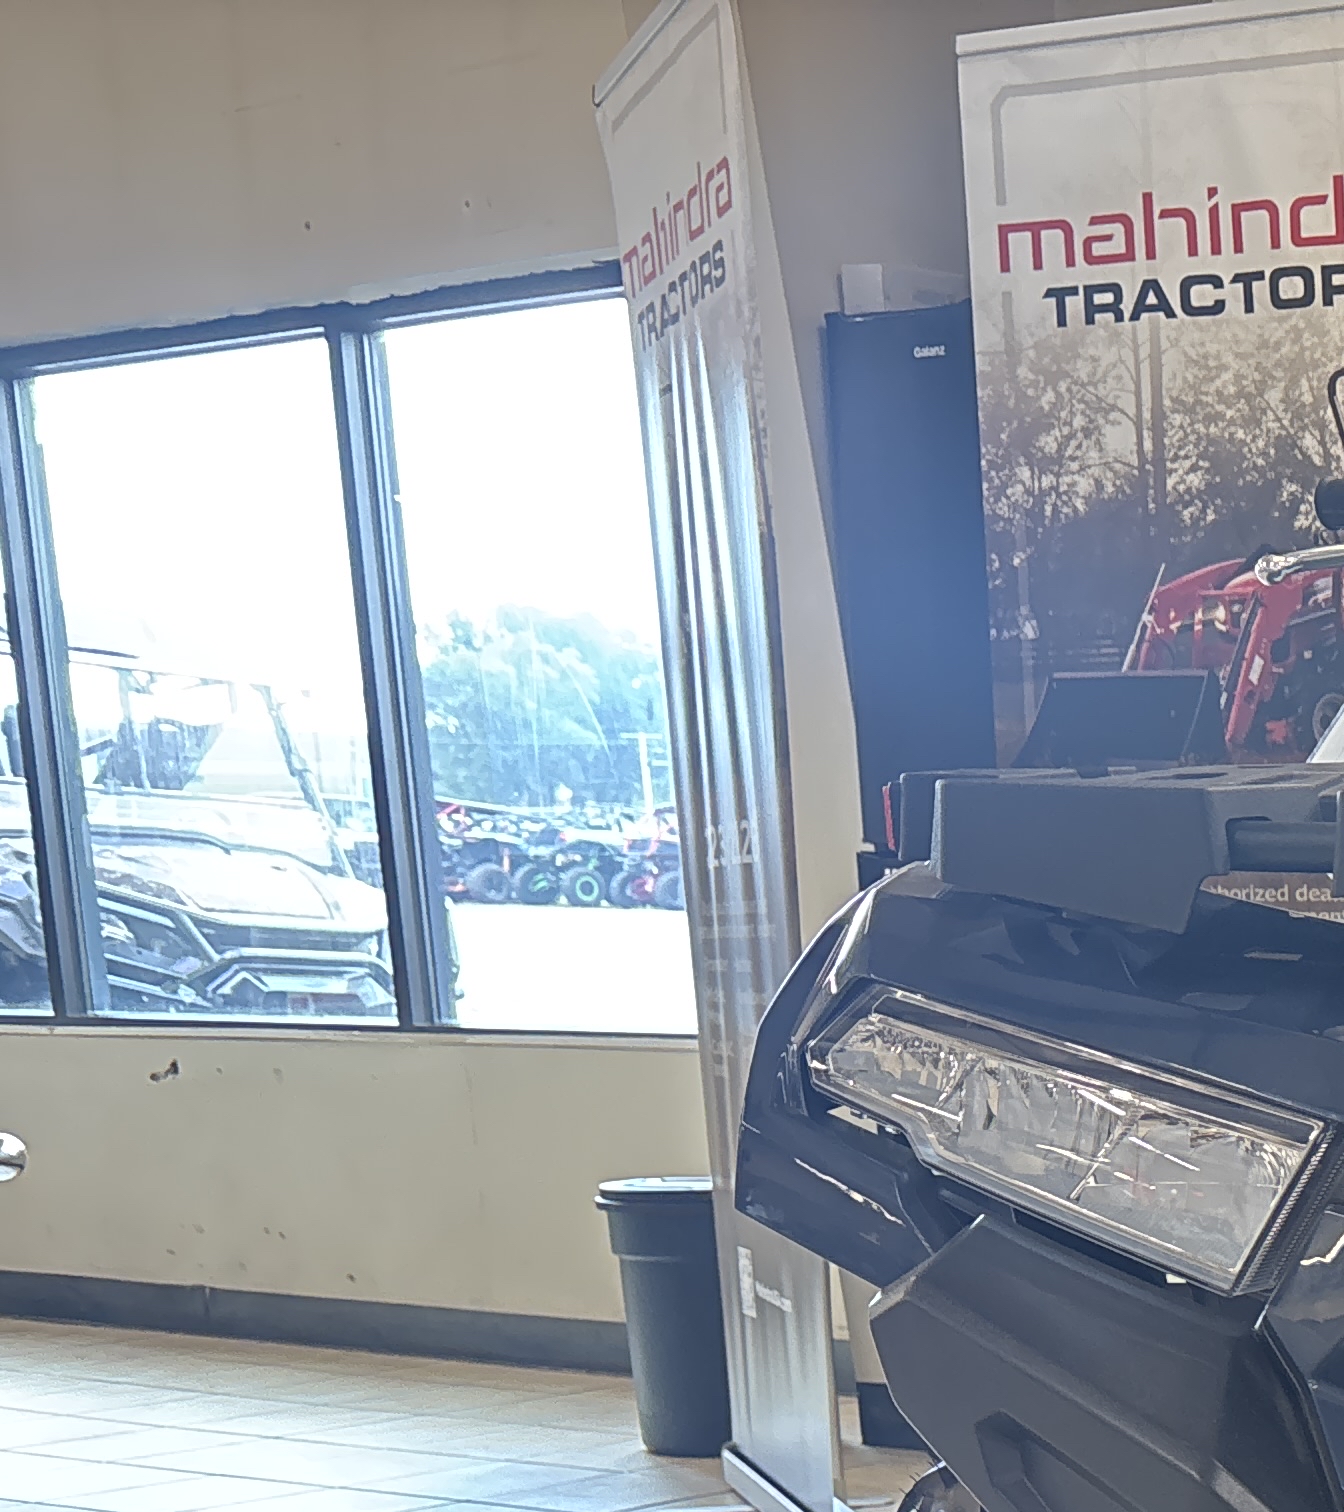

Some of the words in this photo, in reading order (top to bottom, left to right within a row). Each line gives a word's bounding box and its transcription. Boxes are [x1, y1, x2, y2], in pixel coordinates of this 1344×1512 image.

[622, 156, 732, 299] mahindra
[637, 239, 726, 354] TRACTORS
[1210, 884, 1288, 902] horized
[1295, 884, 1341, 902] dea
